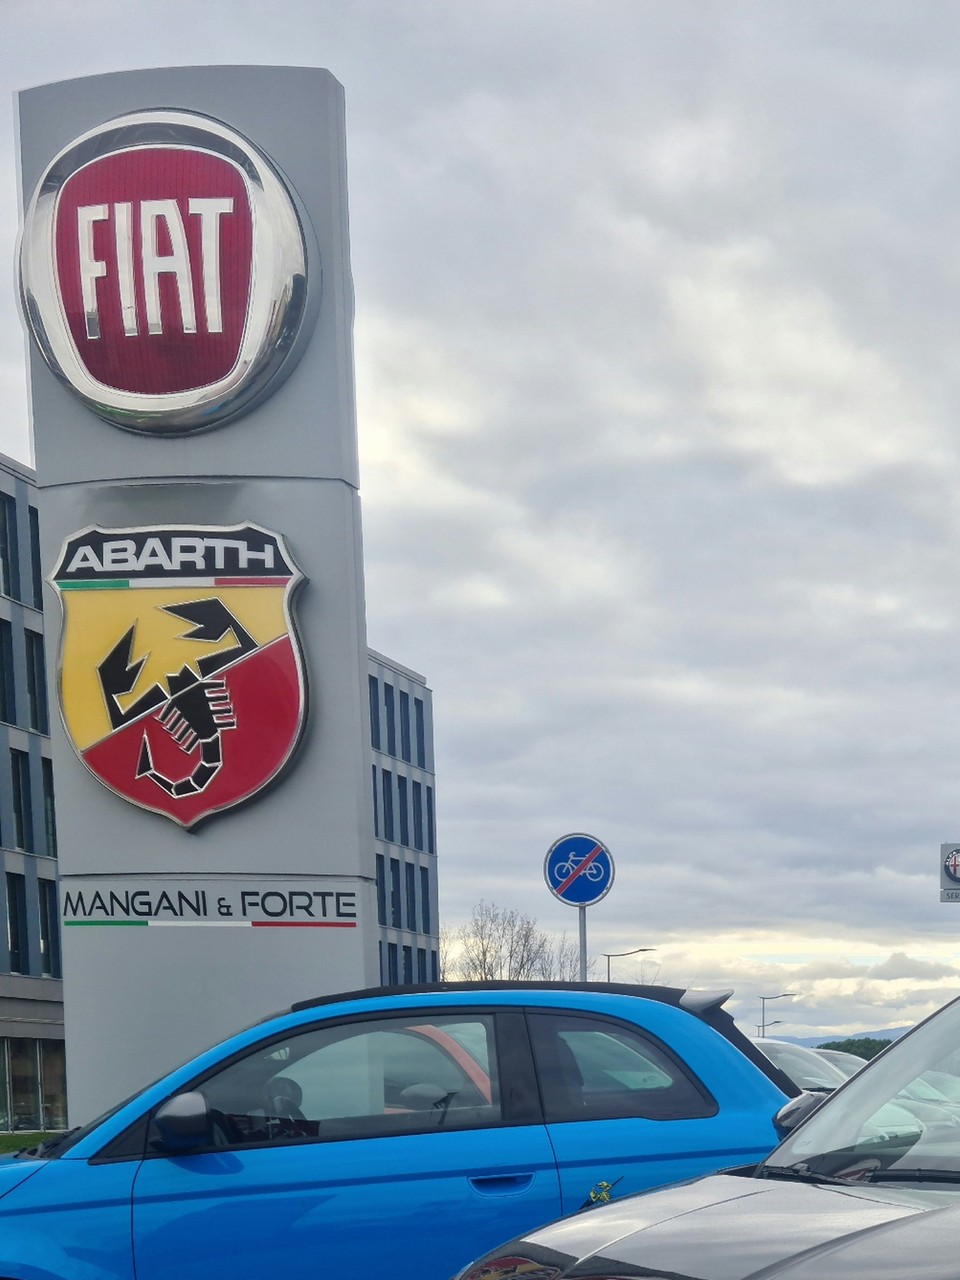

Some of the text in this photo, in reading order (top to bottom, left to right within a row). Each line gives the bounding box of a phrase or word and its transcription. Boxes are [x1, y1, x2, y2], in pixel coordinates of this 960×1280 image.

[76, 197, 234, 340] FIAT
[66, 537, 276, 573] ABARTH
[63, 890, 357, 918] MANGANI & FORTE
